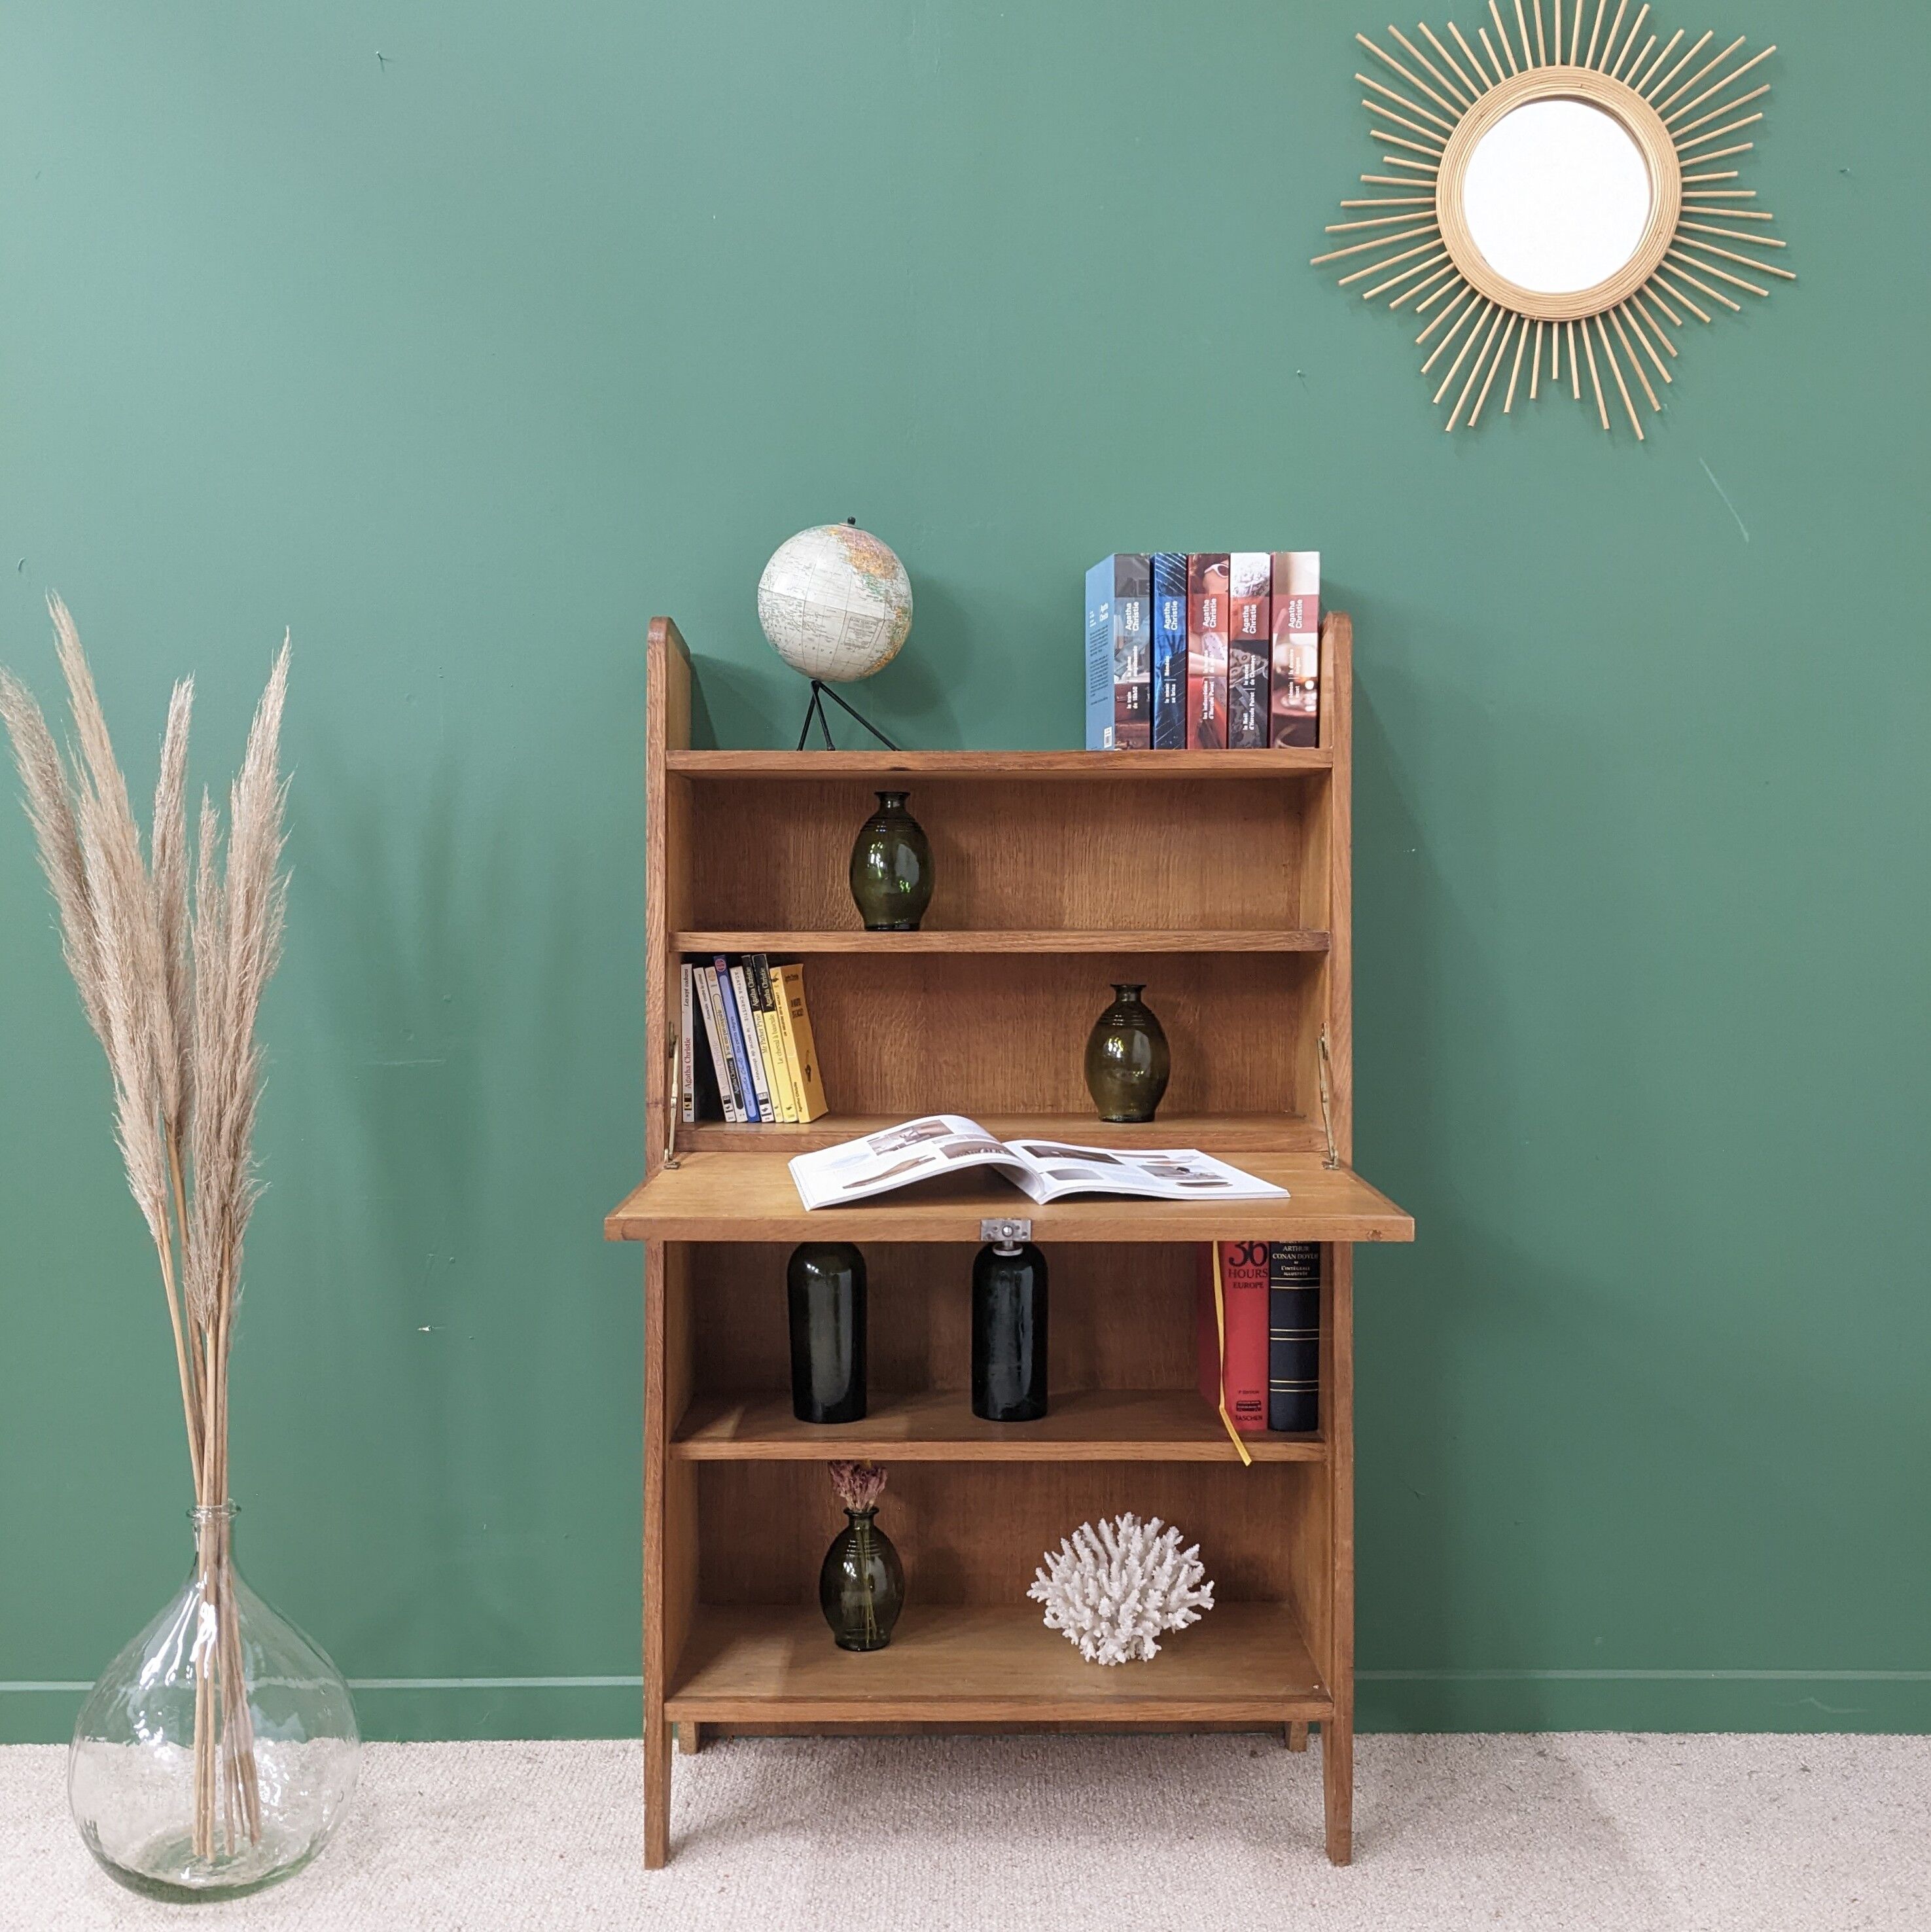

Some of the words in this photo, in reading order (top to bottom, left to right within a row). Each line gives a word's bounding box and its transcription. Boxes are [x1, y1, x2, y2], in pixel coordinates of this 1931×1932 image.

[745, 967, 754, 988] Christie
[760, 967, 768, 988] Christie
[739, 995, 749, 1020] CHRISTIE
[750, 988, 758, 1007] Agatha
[764, 988, 773, 1007] Agatha
[1229, 1241, 1268, 1267] 36
[1228, 1268, 1267, 1279] HOURS
